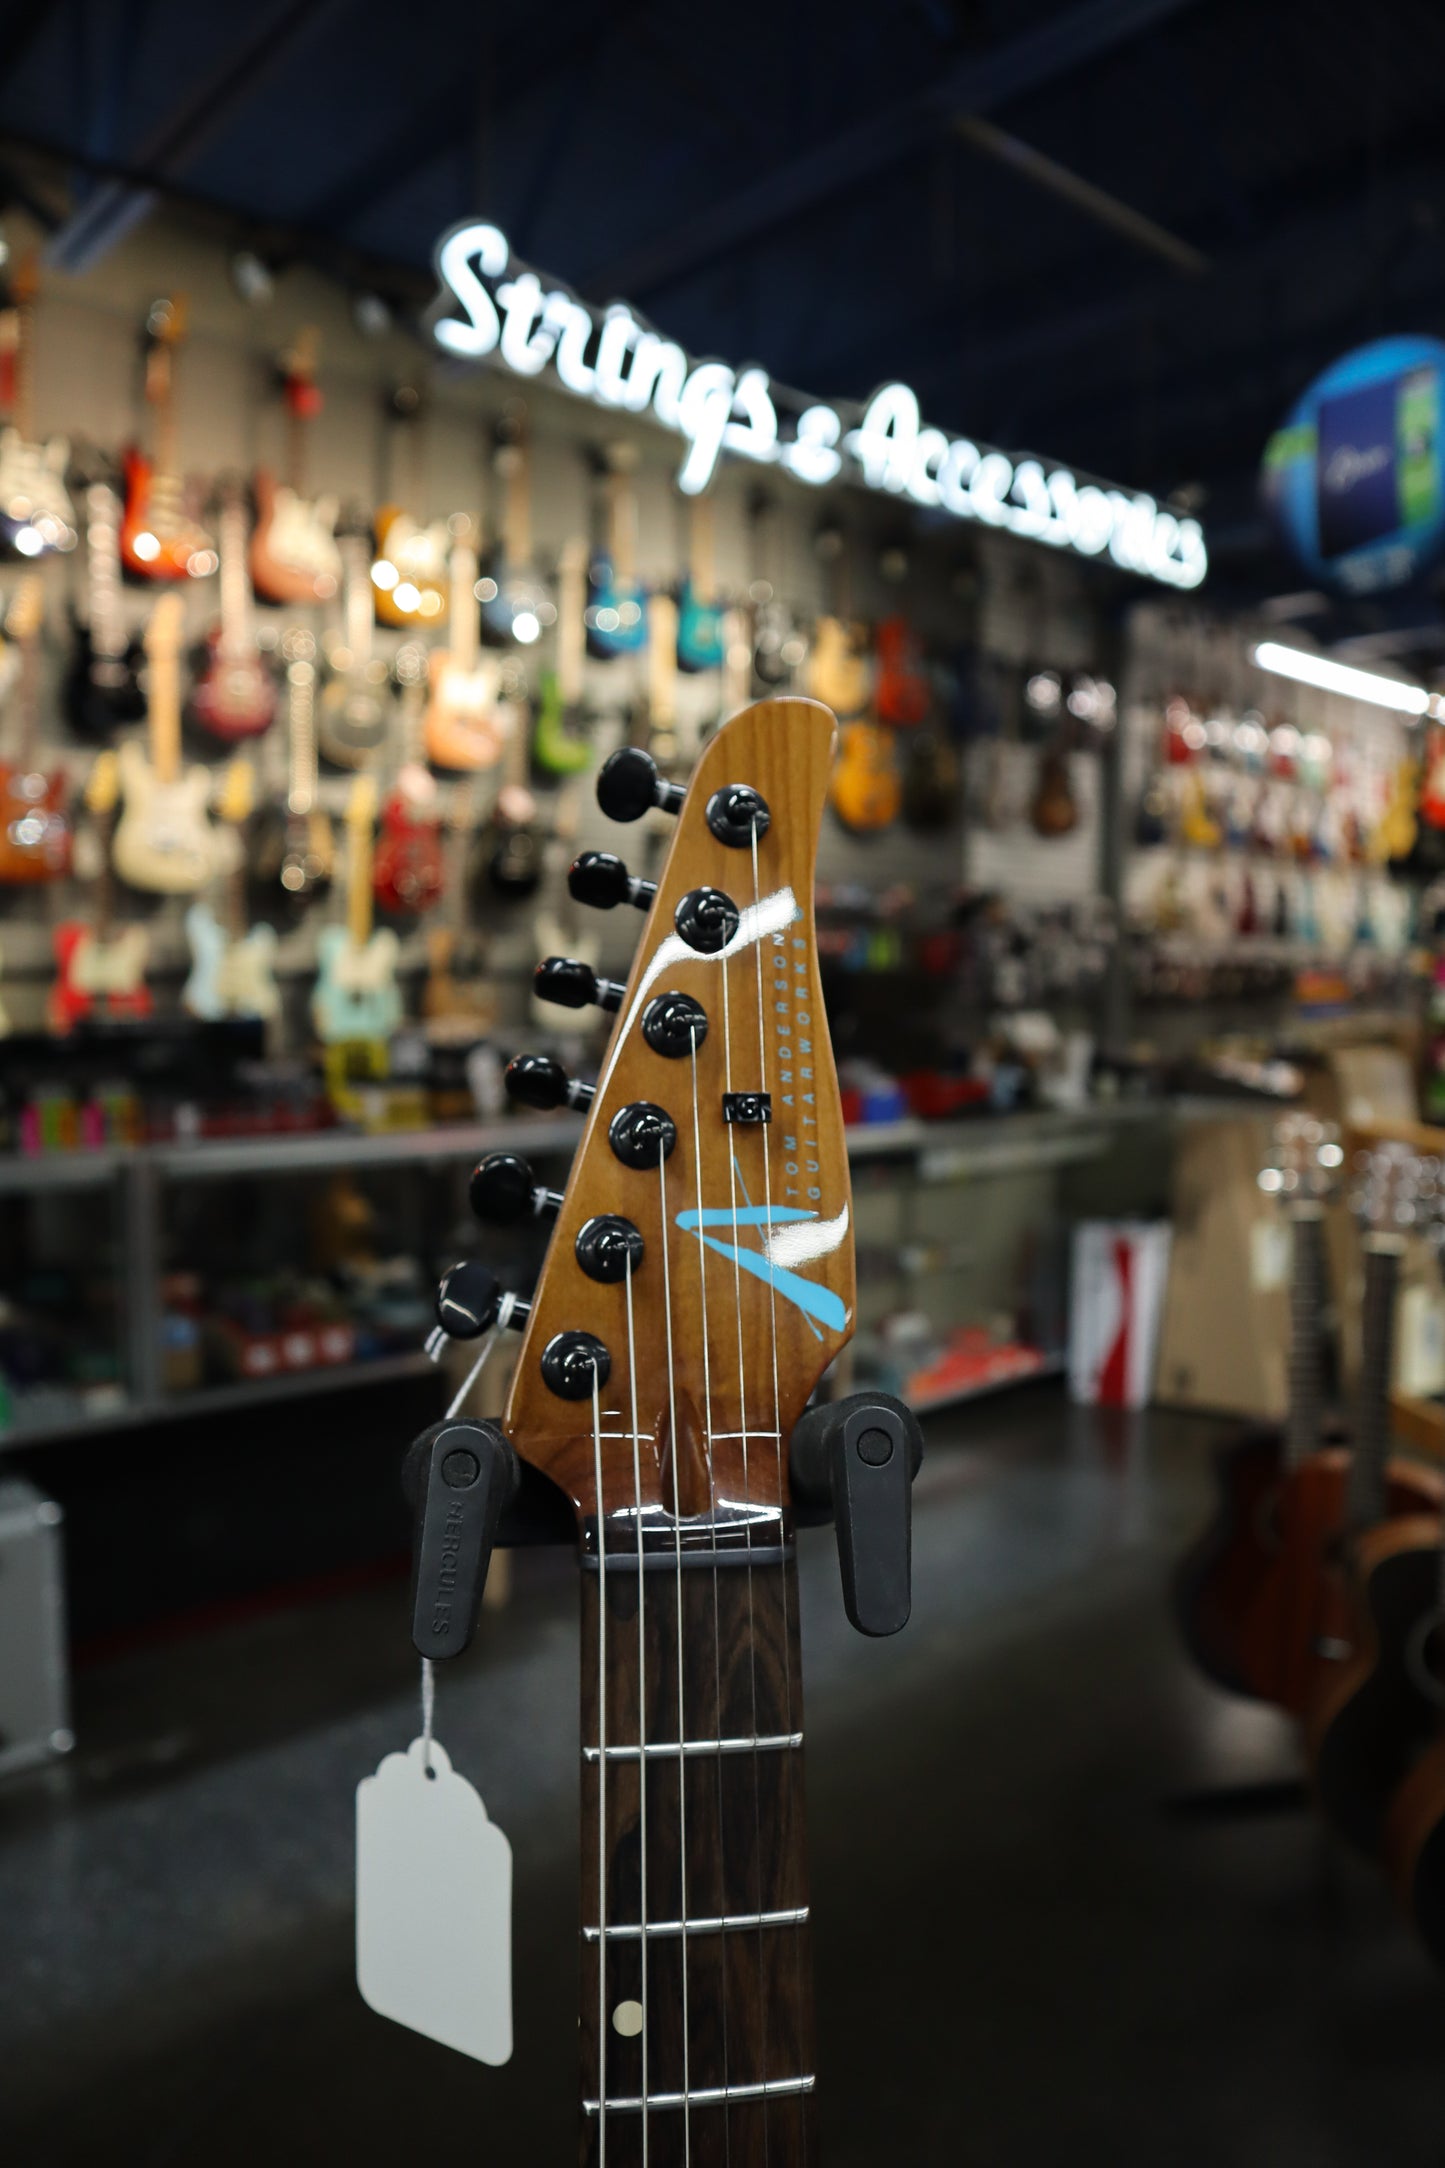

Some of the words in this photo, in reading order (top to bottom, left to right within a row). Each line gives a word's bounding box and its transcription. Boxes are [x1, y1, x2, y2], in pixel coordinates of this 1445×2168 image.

[434, 223, 779, 494] Strings
[845, 382, 1207, 588] Accessories
[773, 932, 794, 1107] ANDERSON
[793, 938, 821, 1200] GUITARWORKS
[784, 1135, 799, 1197] TOM
[432, 1501, 464, 1635] HERCULES
